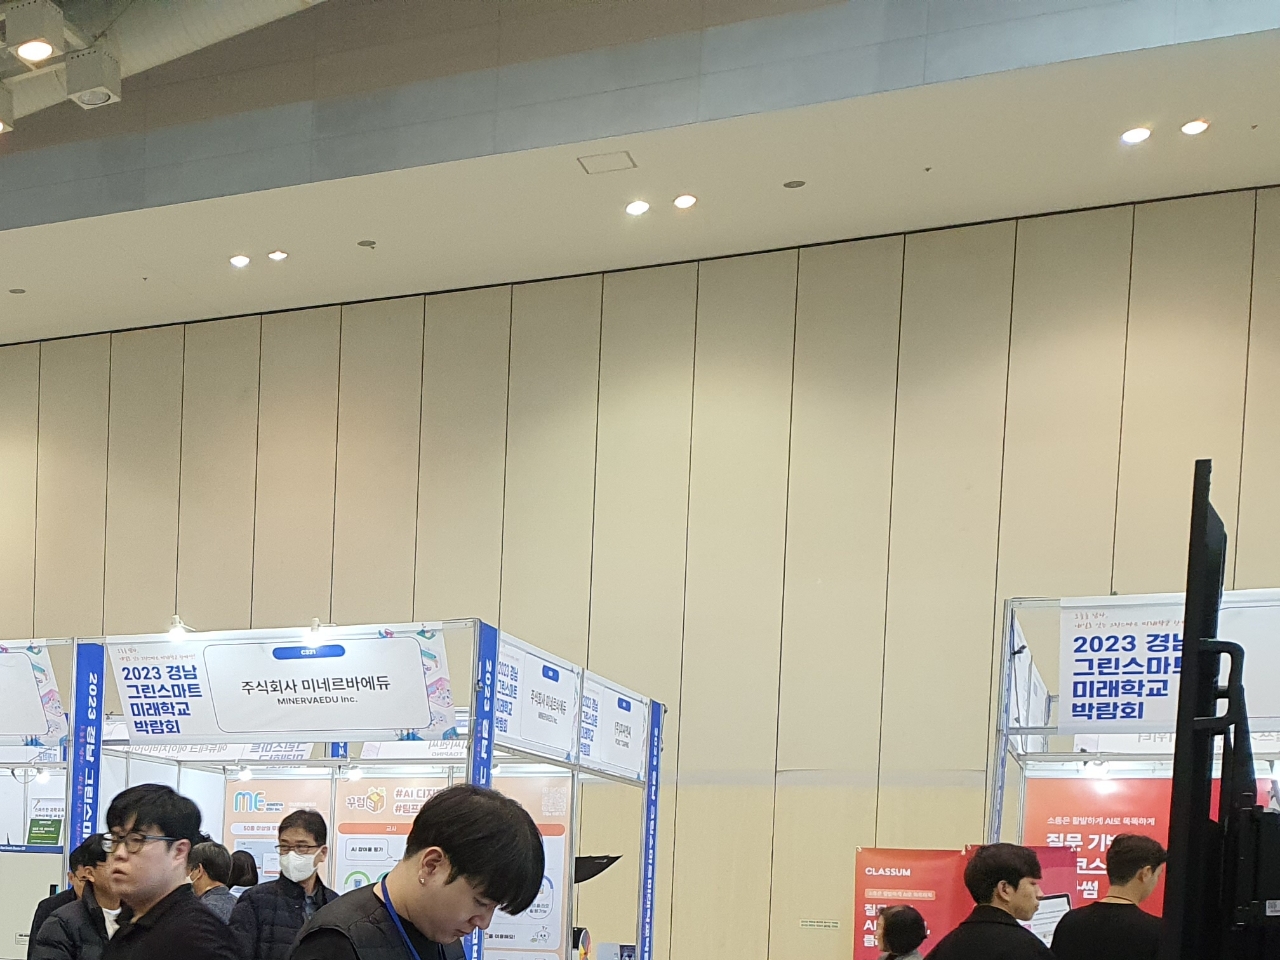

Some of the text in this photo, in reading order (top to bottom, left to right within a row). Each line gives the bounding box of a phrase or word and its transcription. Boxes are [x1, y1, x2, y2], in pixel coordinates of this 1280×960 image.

[1073, 635, 1136, 653] 2023
[122, 665, 198, 681] 2023 경남
[127, 683, 203, 699] 그린스마트
[241, 675, 391, 696] 주식회사 미네르바에듀
[483, 659, 493, 711] 2023
[1072, 680, 1169, 698] 미래학교
[88, 672, 98, 720] 2023
[277, 695, 358, 706] MINERVAEDU Inc.
[131, 702, 191, 718] 미래학교
[1072, 702, 1144, 720] 박람회
[134, 719, 181, 734] 박람회
[85, 726, 96, 763] 경남
[1072, 816, 1103, 825] 활발하게
[865, 867, 911, 876] CLASSUM
